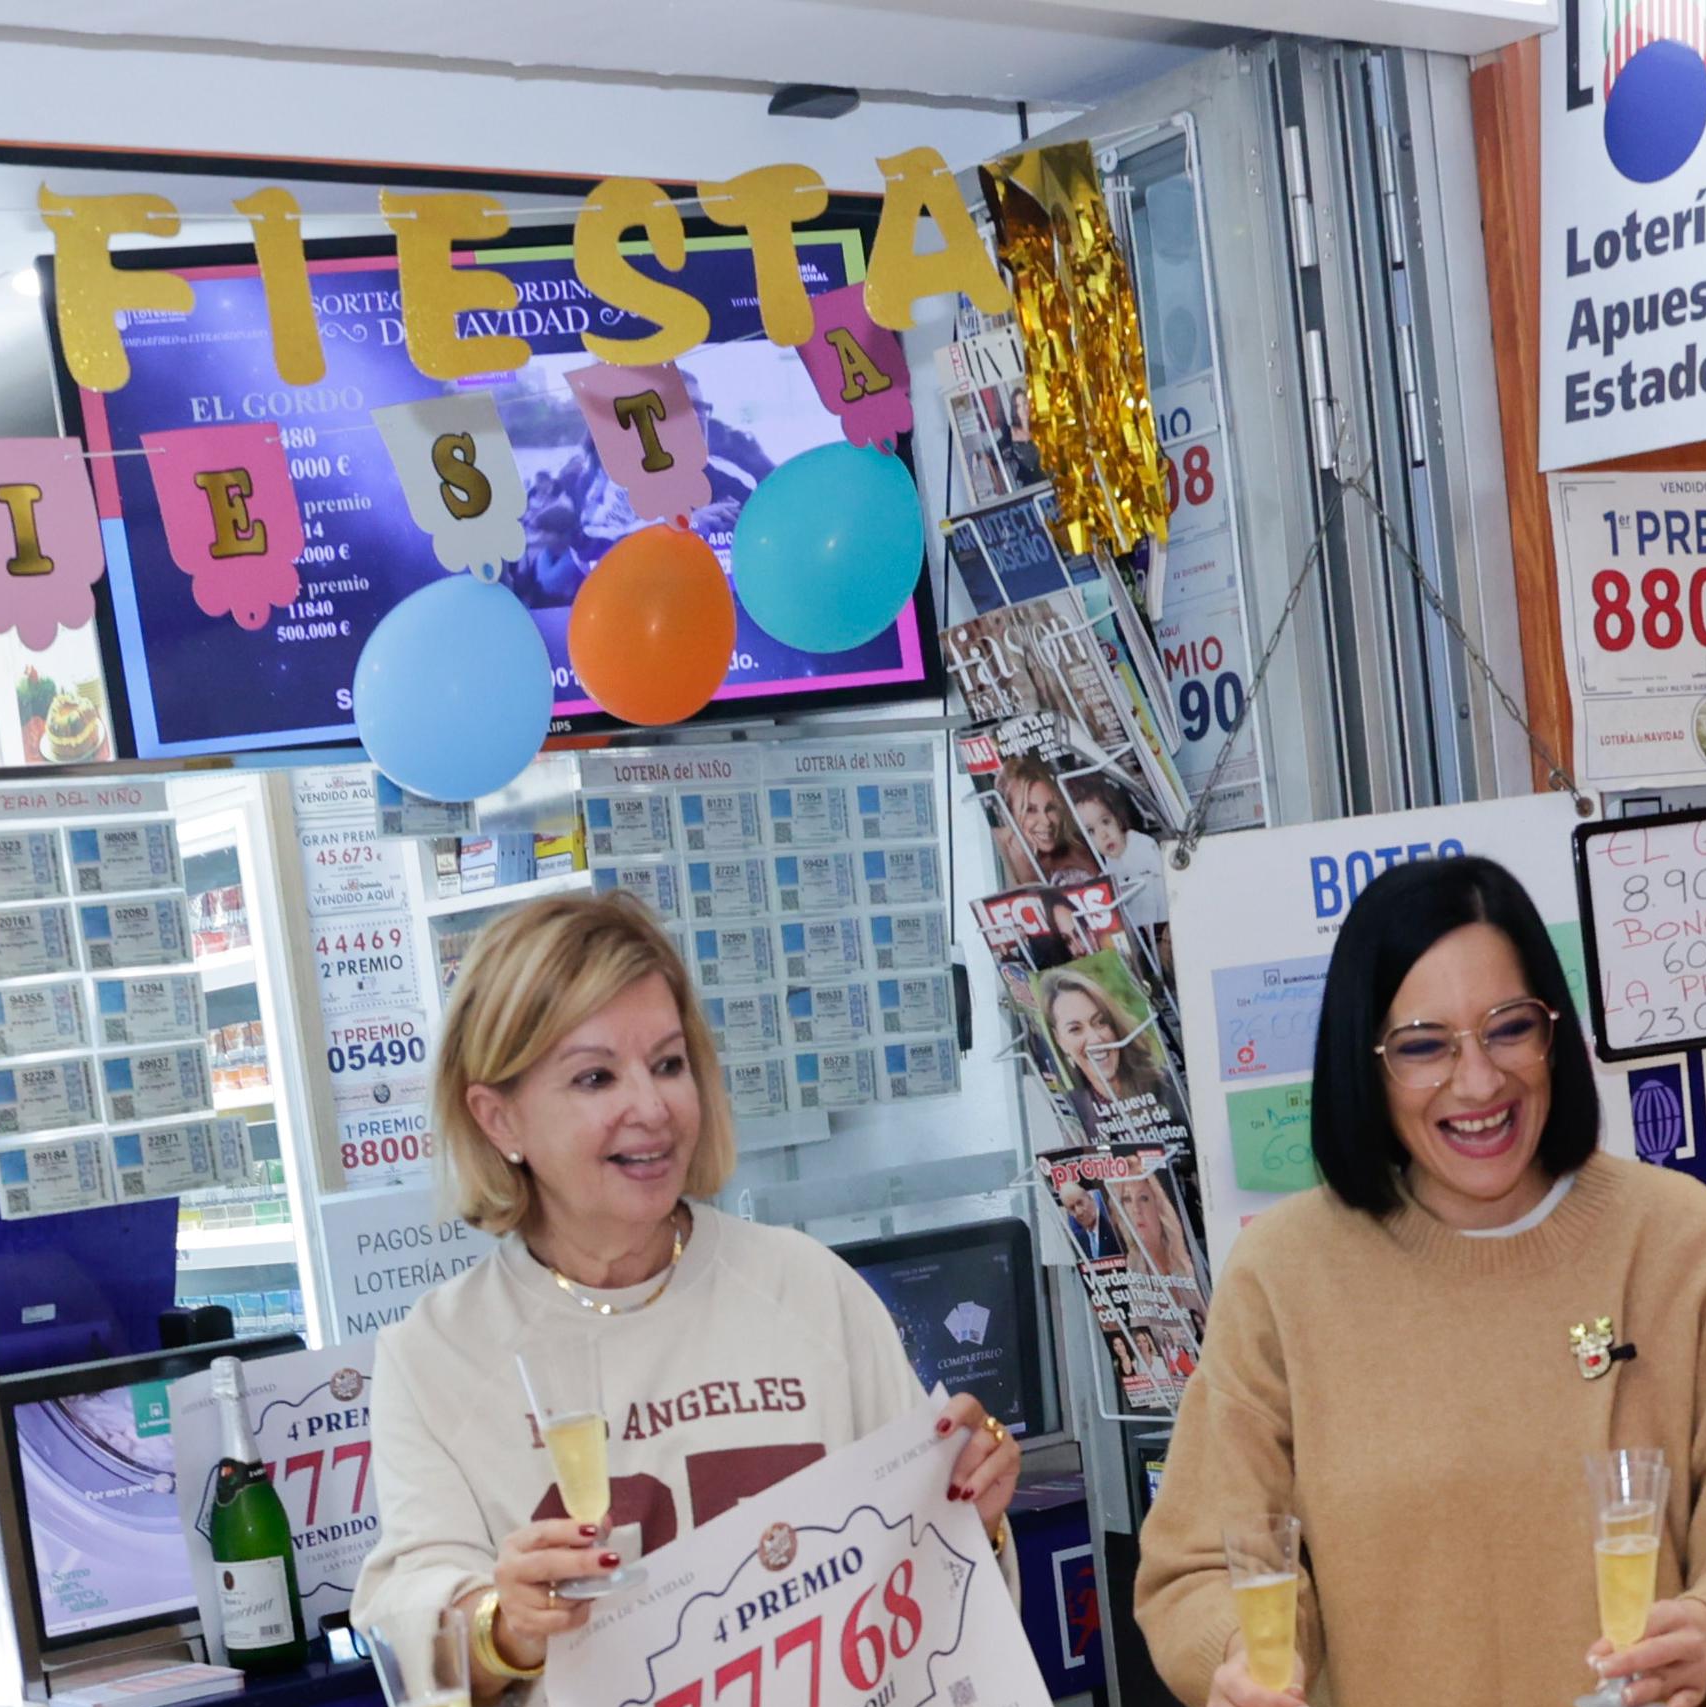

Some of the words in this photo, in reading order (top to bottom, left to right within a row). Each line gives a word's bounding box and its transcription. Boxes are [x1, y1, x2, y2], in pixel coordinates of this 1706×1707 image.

[38, 146, 1014, 393] FIESTA
[190, 397, 234, 421] EL
[243, 387, 365, 418] GORDO
[1603, 510, 1632, 556] 1er
[288, 600, 334, 620] 11840
[276, 622, 337, 643] 500.000
[1164, 634, 1224, 683] MIO
[1178, 670, 1245, 743] 90
[1600, 731, 1635, 746] LOTERÍA
[1643, 728, 1684, 743] NAVIDAD
[674, 762, 694, 780] del
[697, 759, 732, 779] NIÑO
[850, 753, 870, 769] del
[874, 750, 905, 768] NIÑO
[57, 791, 88, 806] DEL
[299, 789, 348, 804] VENDIDO
[352, 787, 374, 801] AQU
[303, 832, 340, 847] GRAN
[344, 829, 376, 844] PREM
[1597, 826, 1669, 867] EL
[317, 847, 373, 865] 45.673
[314, 891, 364, 906] VENDIDO
[337, 955, 403, 977] PREMIO
[1604, 971, 1650, 1014] LA
[345, 1022, 414, 1043] PREMIO
[327, 1037, 426, 1073] 05490
[358, 1115, 426, 1137] PREMIO
[341, 1132, 435, 1169] 88008
[1050, 1154, 1131, 1192] pronto
[356, 1226, 434, 1256] PAGOS
[439, 1221, 468, 1241] DE
[354, 1256, 448, 1295] LOTERÍA
[346, 1304, 413, 1336] NAVID
[621, 1377, 807, 1443] ANGELES
[292, 1514, 378, 1551] VENDIDO
[736, 1546, 864, 1634] PREMIO
